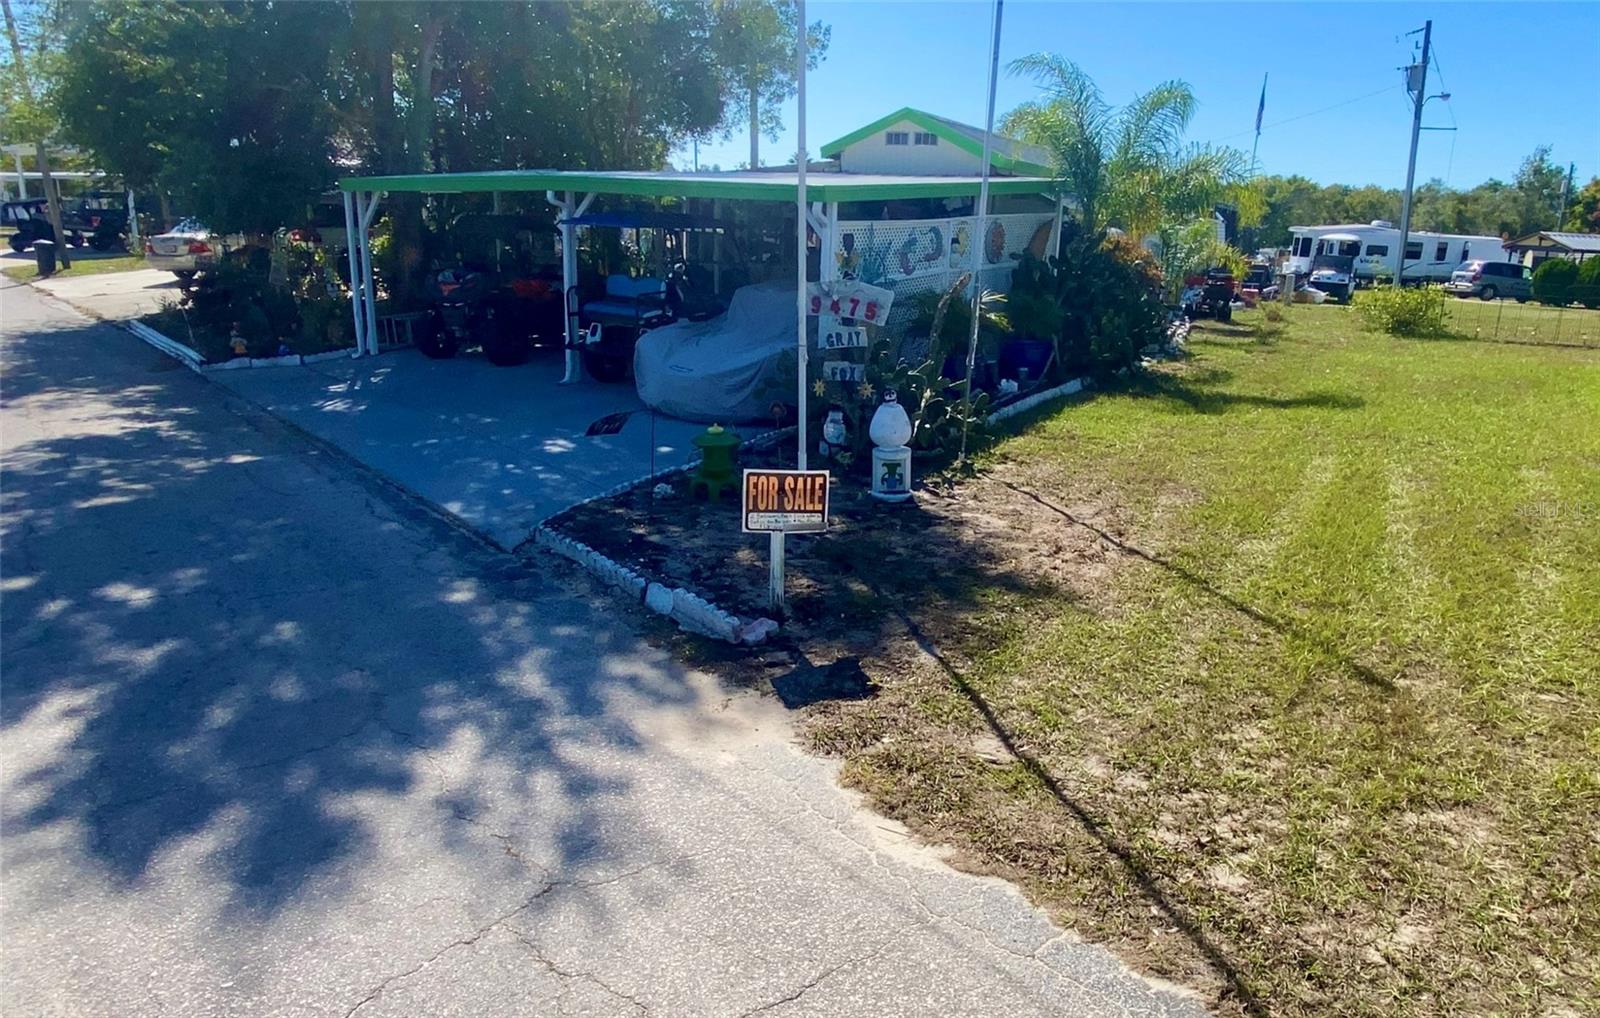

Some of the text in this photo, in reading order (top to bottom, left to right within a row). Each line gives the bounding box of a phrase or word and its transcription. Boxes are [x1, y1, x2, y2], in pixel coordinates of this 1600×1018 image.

[826, 331, 861, 347] GRAY
[831, 366, 856, 381] FOX
[748, 475, 824, 511] FOR SALE
